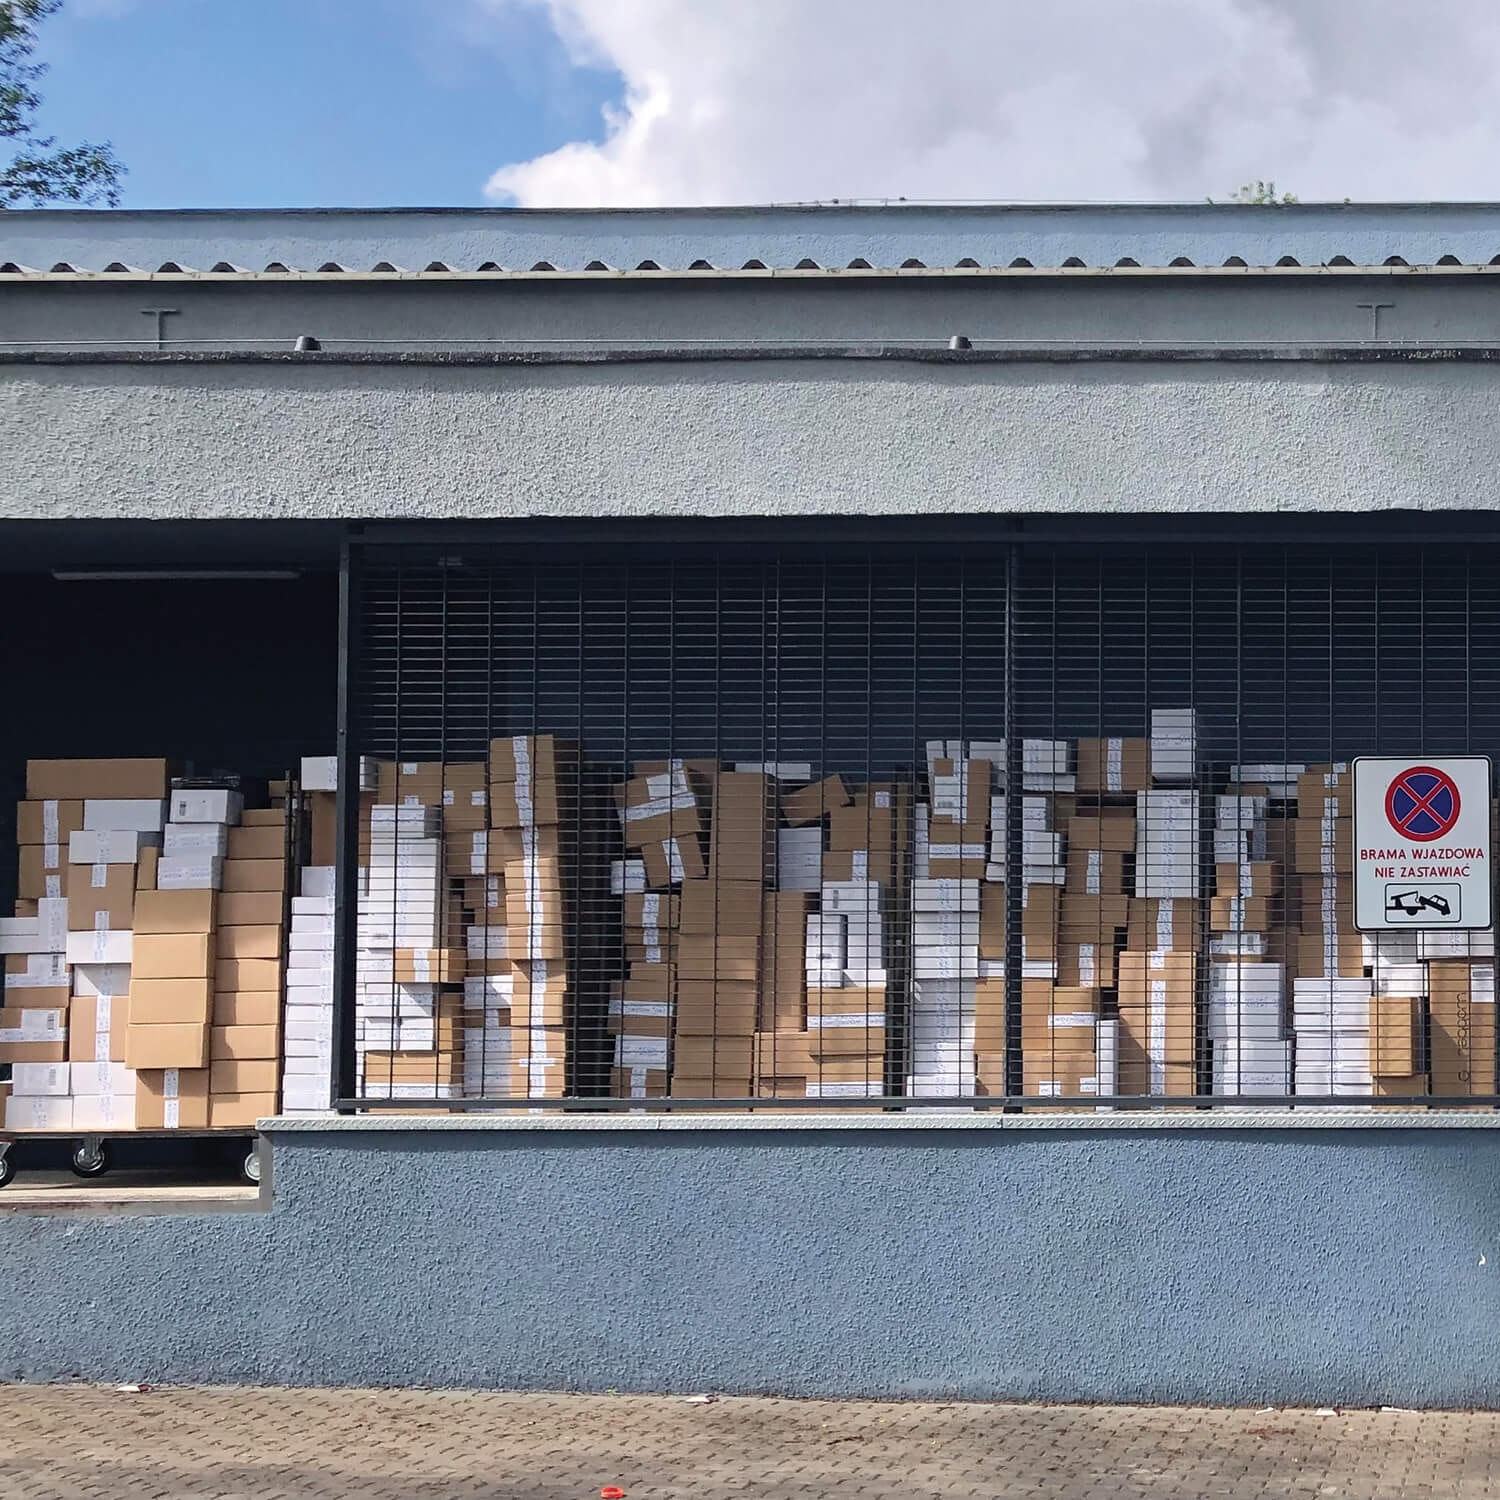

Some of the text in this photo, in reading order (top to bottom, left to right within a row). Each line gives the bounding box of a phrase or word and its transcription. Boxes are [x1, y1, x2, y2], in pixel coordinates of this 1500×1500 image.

[1360, 848, 1484, 860] BRAMA WJAZDOWA
[1374, 863, 1471, 878] NIE ZASTAWIAĆ
